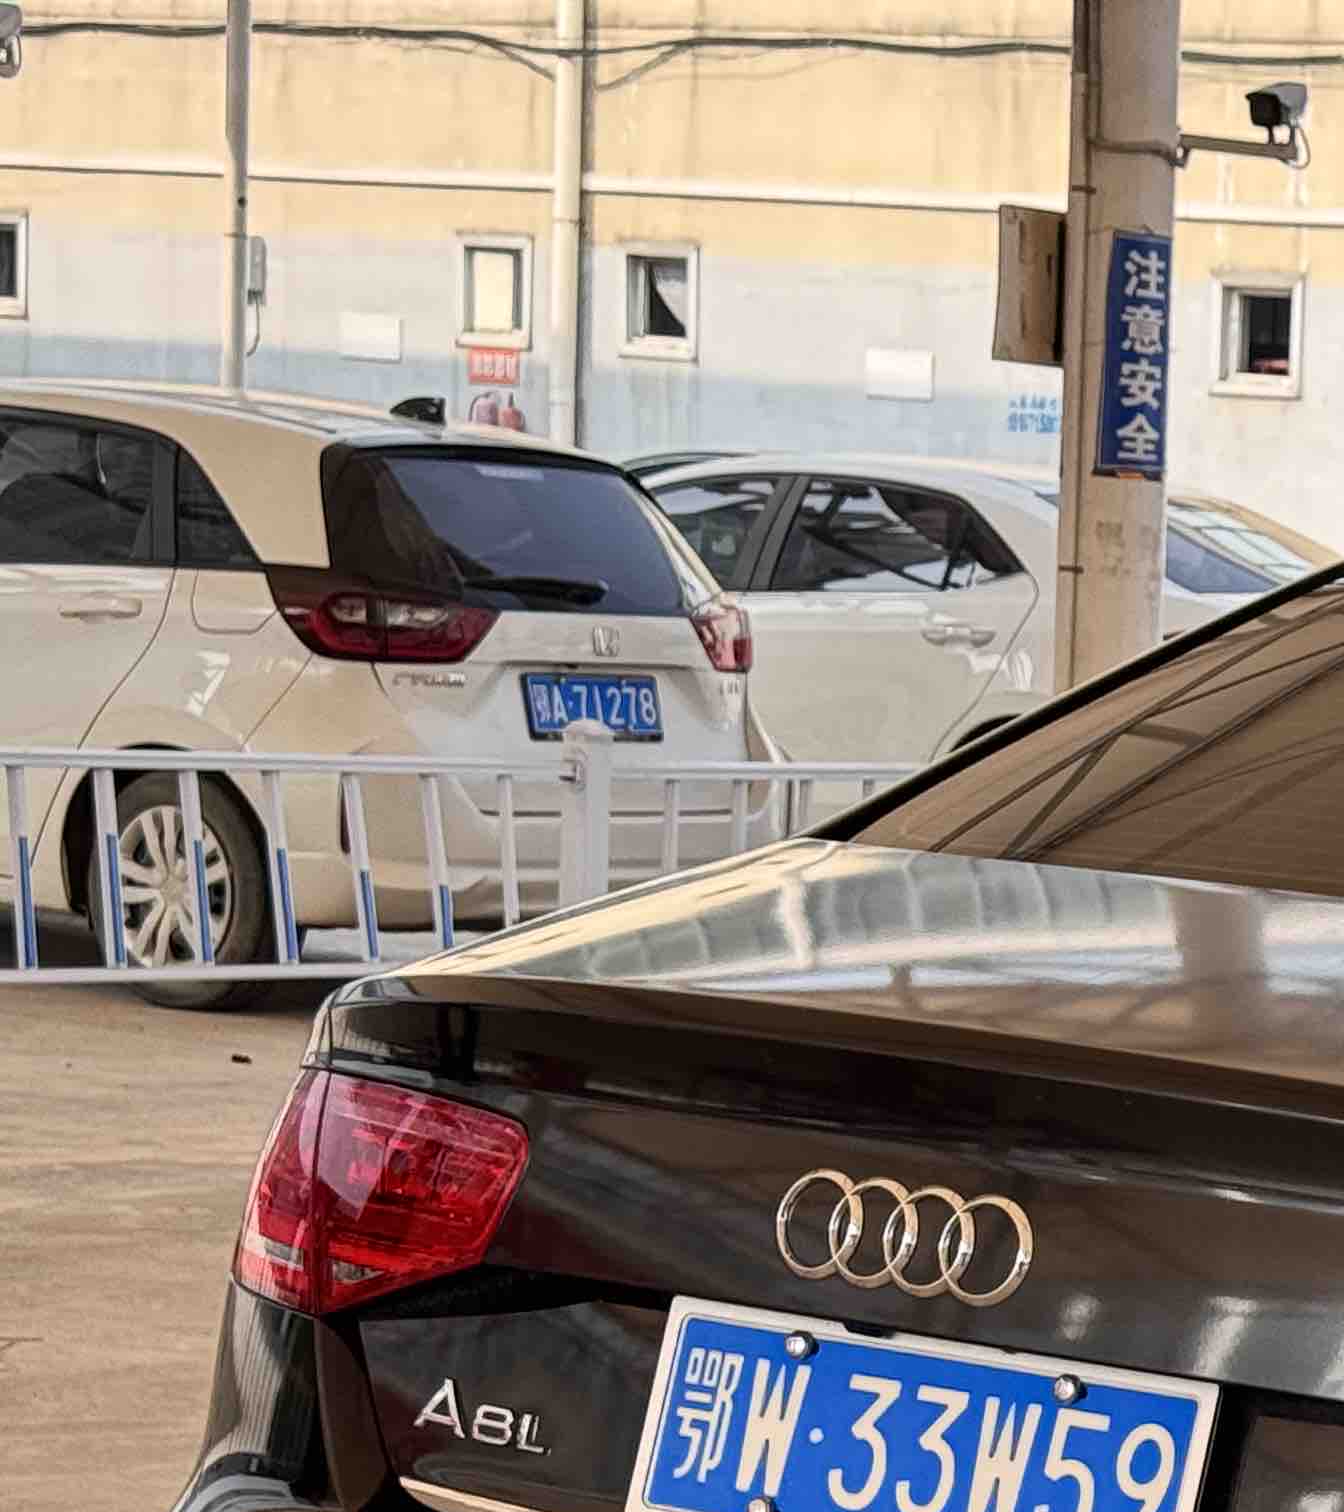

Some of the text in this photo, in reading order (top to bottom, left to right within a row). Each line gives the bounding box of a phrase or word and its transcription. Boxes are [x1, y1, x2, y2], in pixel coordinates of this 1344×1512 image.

[1116, 250, 1166, 461] 注意安全
[413, 1378, 545, 1454] A8L
